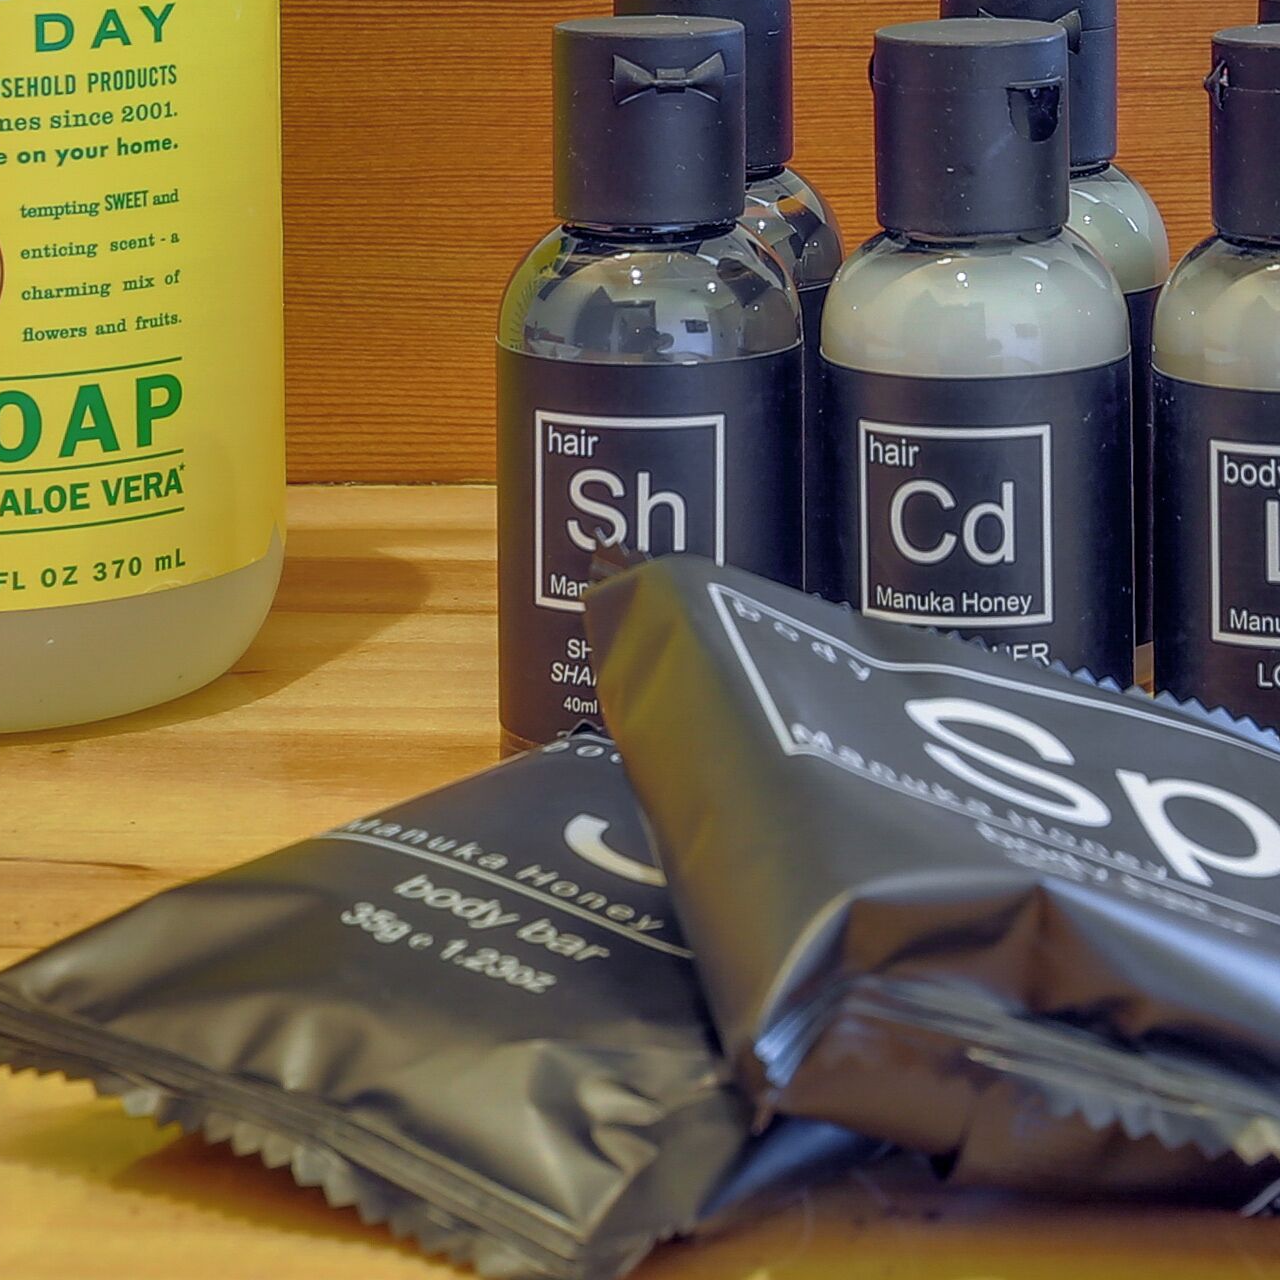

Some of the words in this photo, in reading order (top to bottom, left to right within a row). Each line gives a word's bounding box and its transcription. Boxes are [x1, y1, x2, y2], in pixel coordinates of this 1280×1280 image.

[35, 3, 176, 54] DAY
[87, 64, 177, 93] PRODUCTS
[49, 110, 114, 129] since
[121, 101, 178, 123] 2001.
[17, 149, 47, 164] on
[56, 144, 109, 167] your
[117, 137, 178, 156] home.
[20, 201, 100, 220] tempting
[104, 190, 149, 211] SWEET
[152, 188, 179, 205] and
[20, 242, 98, 259] enticing
[110, 233, 155, 251] scent
[170, 232, 180, 243] a
[21, 282, 111, 300] charming
[123, 275, 155, 291] mix
[164, 269, 181, 285] of
[22, 326, 87, 342] flowers
[95, 319, 127, 336] and
[135, 312, 182, 330] fruits.
[547, 425, 600, 457] hair
[869, 435, 920, 467] hair
[567, 469, 687, 553] Sh
[890, 479, 1016, 564] Cd
[41, 566, 78, 588] OZ
[93, 556, 142, 581] 370
[155, 548, 186, 572] mL
[876, 585, 955, 613] Manuka
[962, 592, 1032, 615] Honey
[563, 696, 598, 714] 40ml
[344, 819, 509, 870] Manuka
[514, 864, 665, 932] Honey
[340, 901, 412, 945] 35g
[393, 874, 519, 930] body
[516, 918, 611, 962] bar
